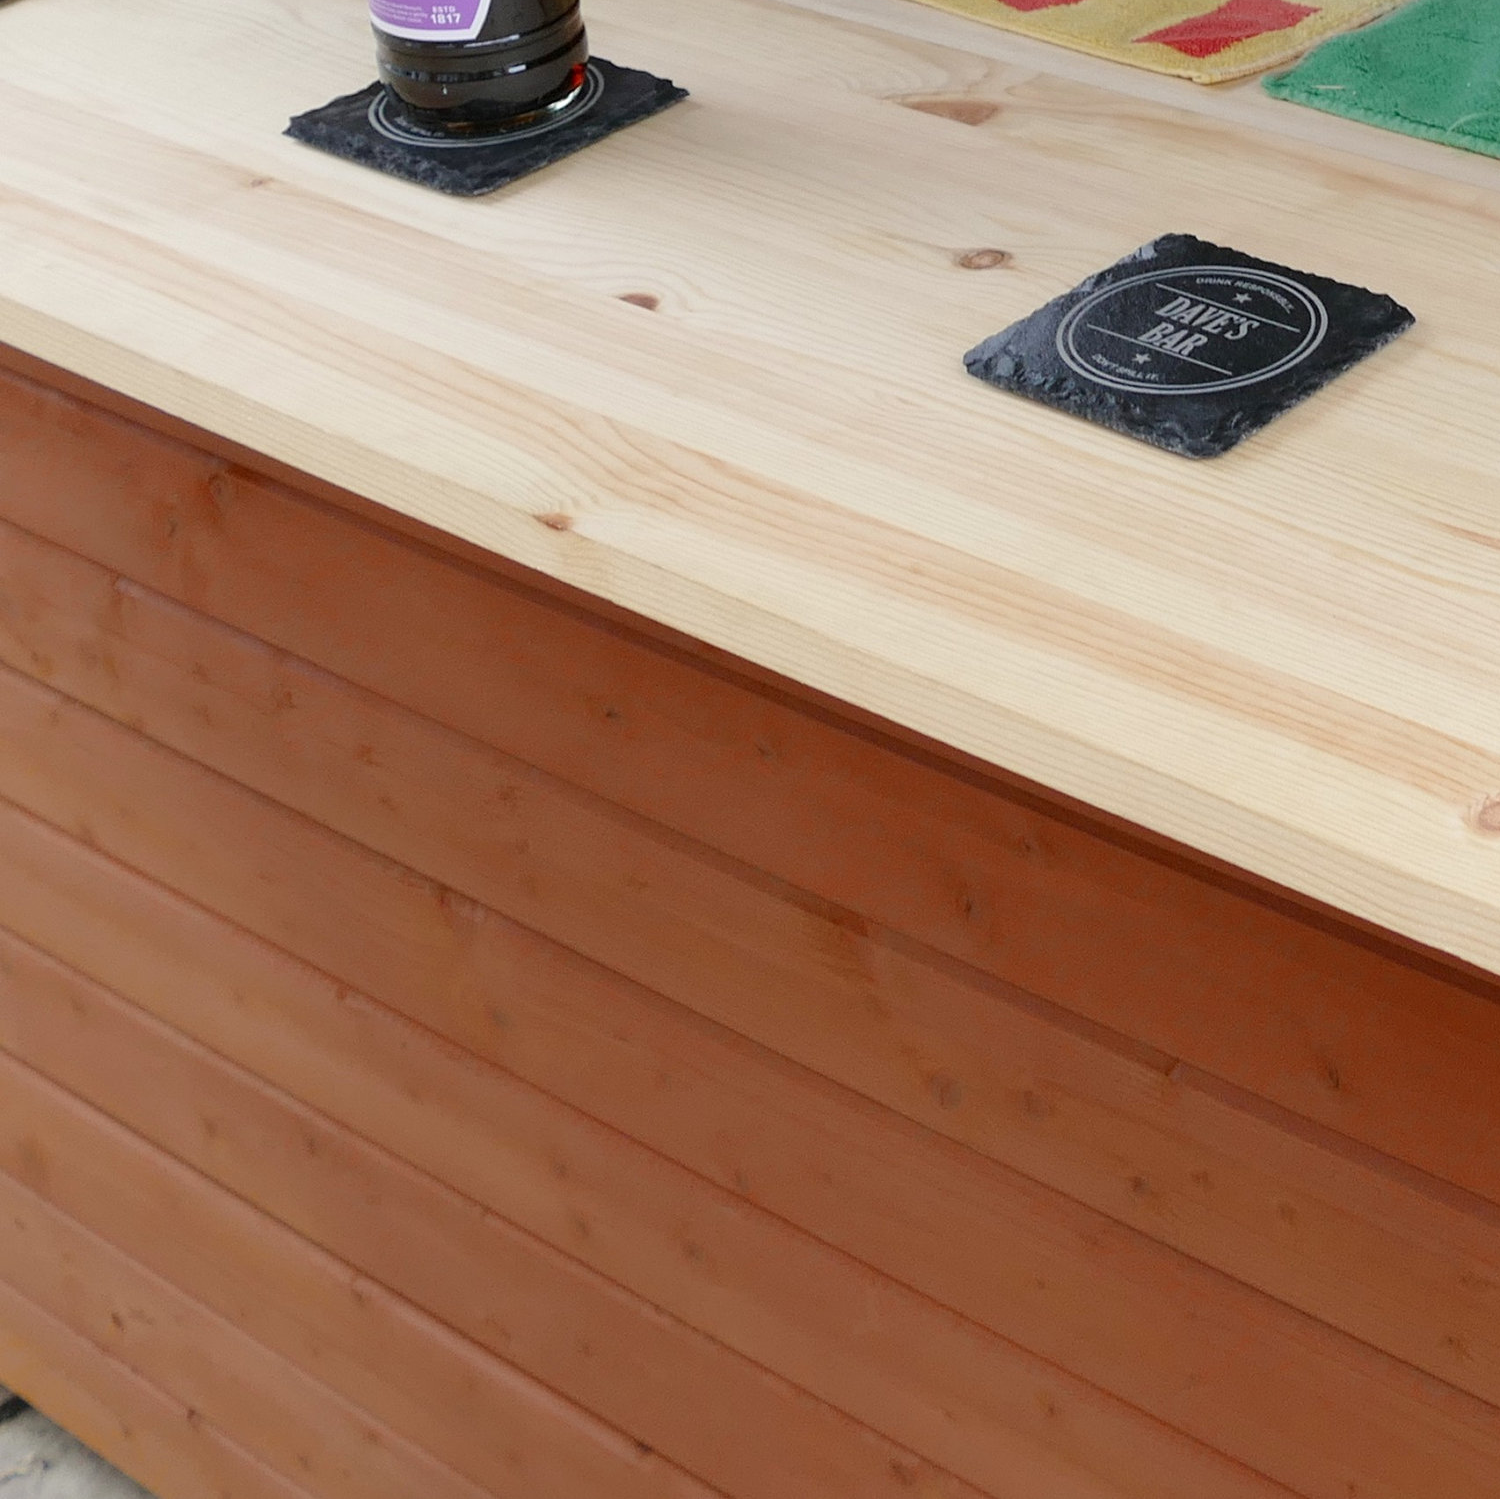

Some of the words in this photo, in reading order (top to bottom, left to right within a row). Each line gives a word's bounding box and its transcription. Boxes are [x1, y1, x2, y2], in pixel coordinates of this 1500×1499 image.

[430, 13, 462, 25] 1817
[1196, 277, 1233, 287] DRINK
[1155, 295, 1260, 341] DAVE'S
[1137, 322, 1209, 357] BAR
